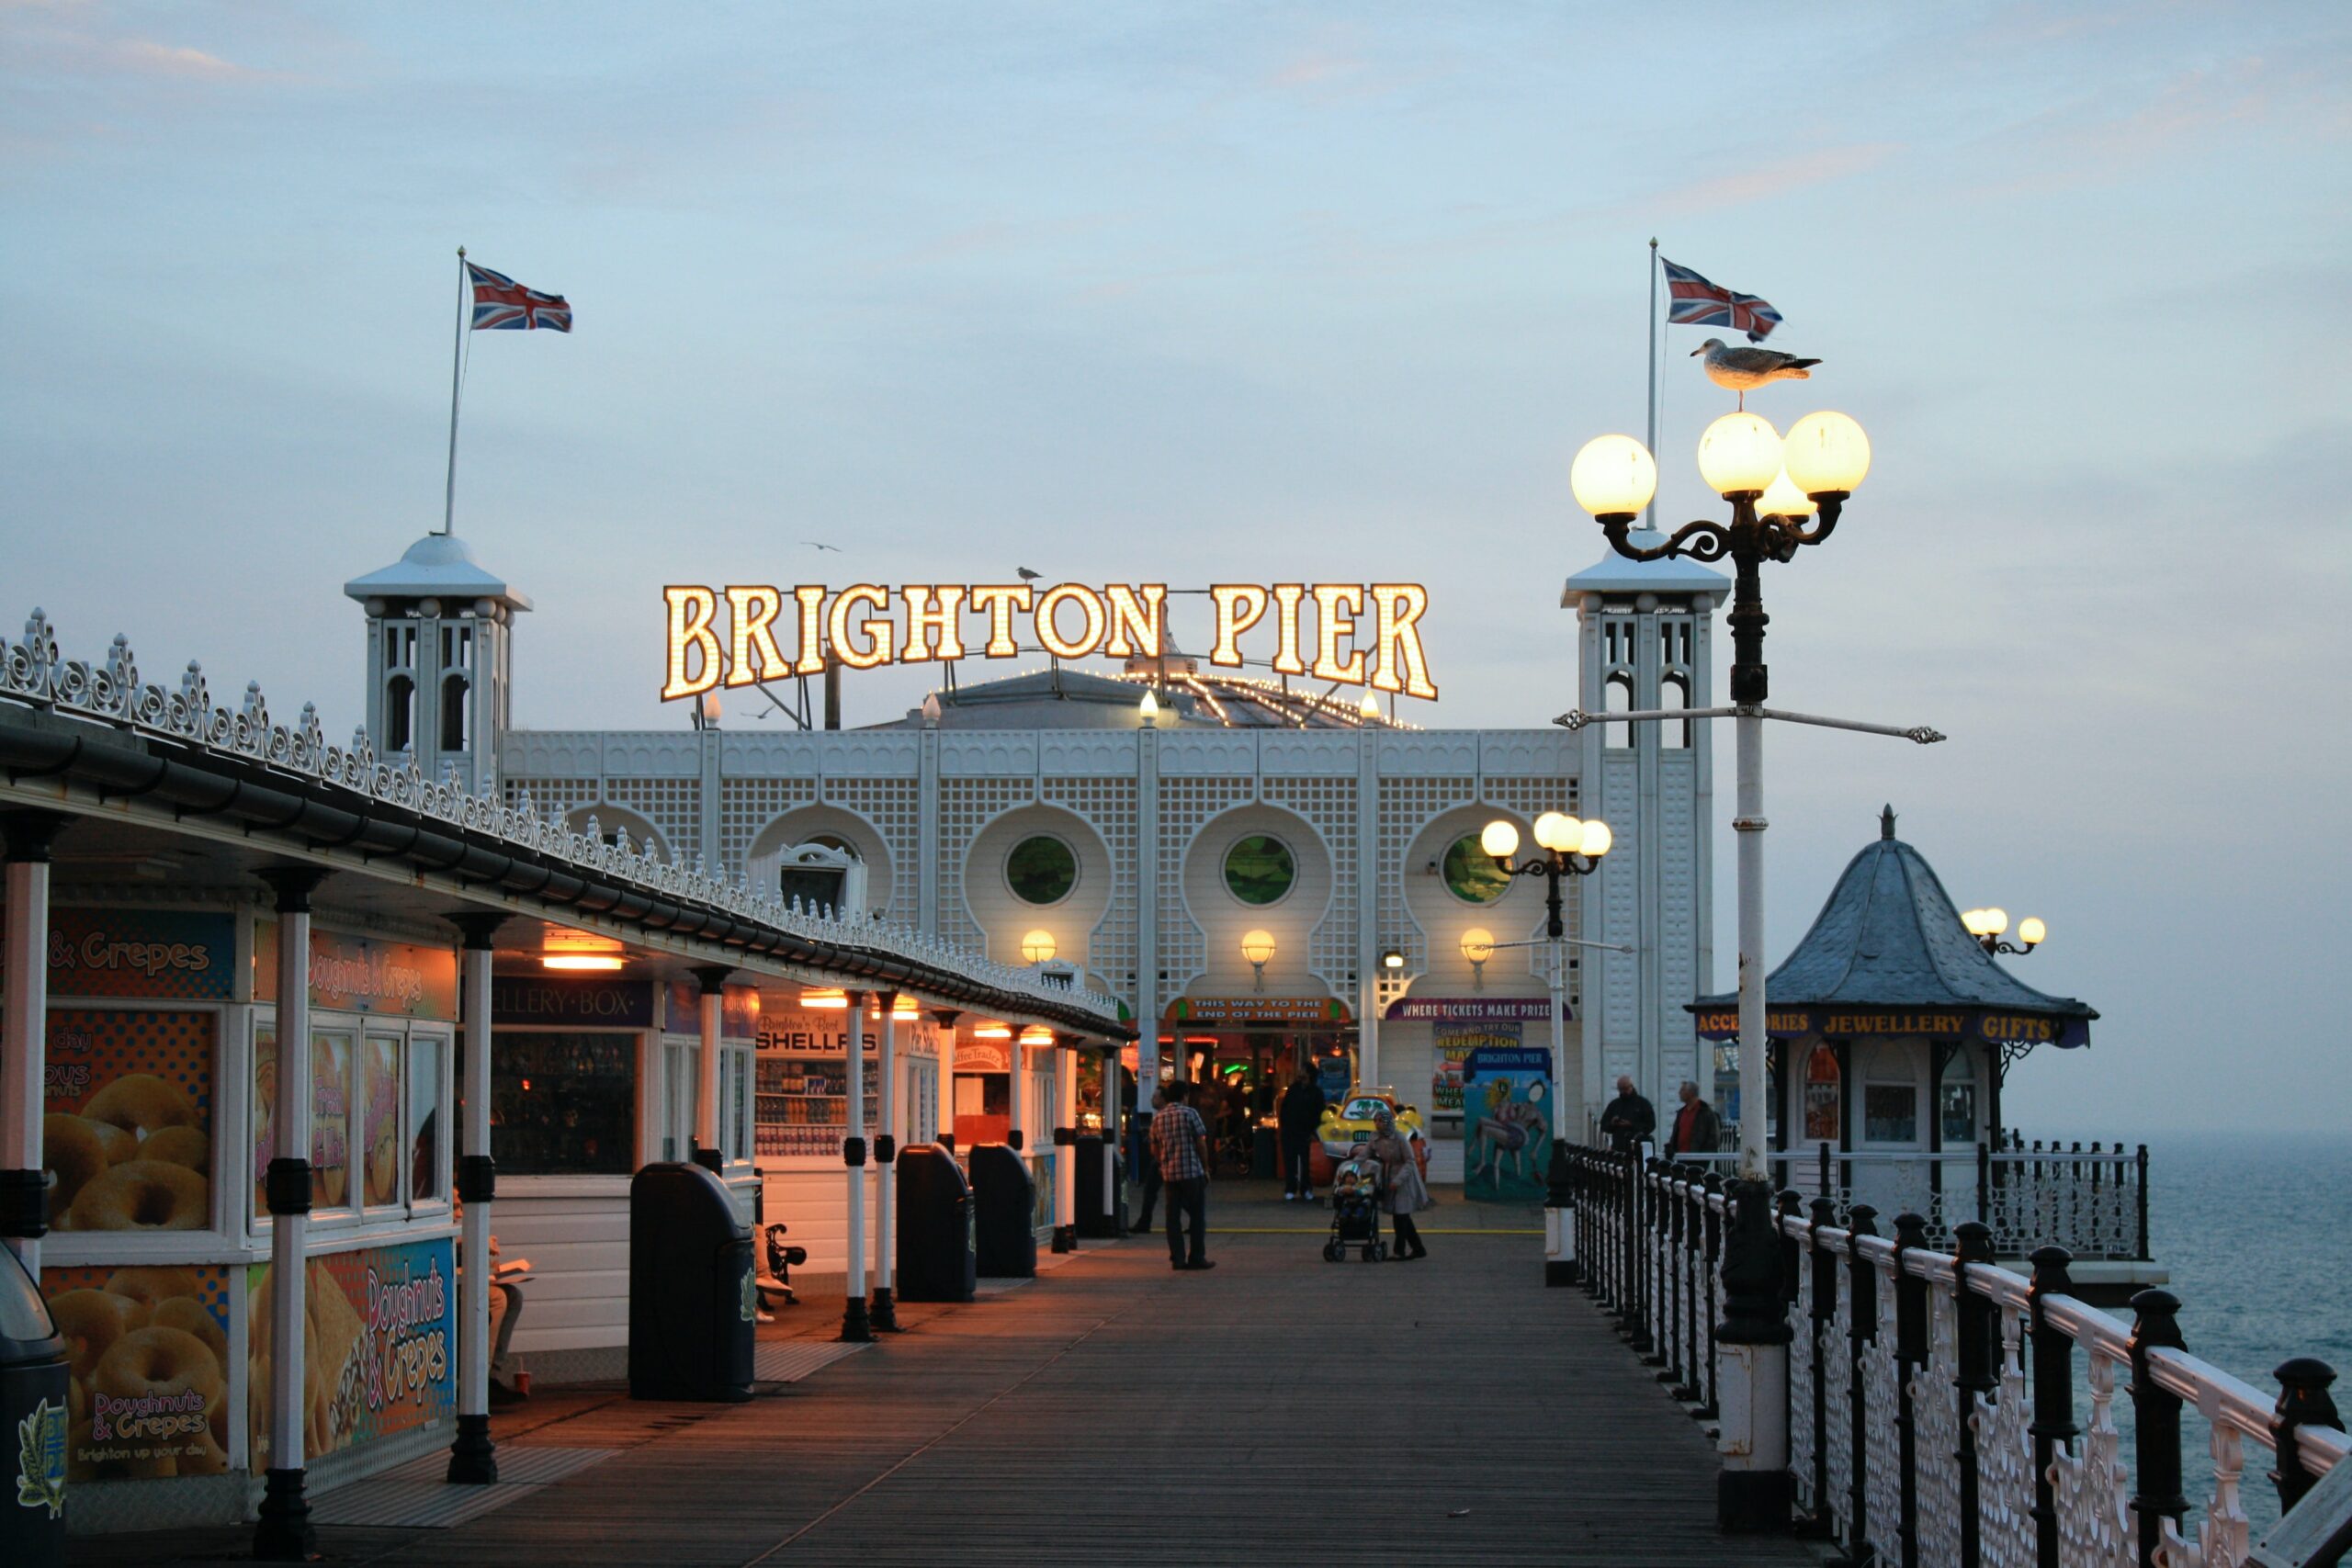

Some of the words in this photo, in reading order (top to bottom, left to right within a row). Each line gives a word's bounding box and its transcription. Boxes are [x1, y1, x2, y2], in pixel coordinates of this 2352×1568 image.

[661, 582, 1168, 702] BRIGHTON
[1209, 582, 1439, 702] PIER
[48, 931, 75, 969] &
[81, 931, 210, 976] Crepes
[309, 942, 371, 1000] Doughnuts
[382, 953, 423, 1008] Crepes
[493, 987, 568, 1015] ELLERY
[580, 989, 629, 1015] BOX
[1193, 999, 1226, 1008] THIS
[1231, 999, 1264, 1008] WAY
[1271, 999, 1290, 1008] TO
[1296, 999, 1322, 1008] THE
[1402, 1004, 1438, 1018] WHERE
[1442, 1004, 1483, 1018] TICKETS
[1487, 1004, 1517, 1018] MAKE
[1521, 1004, 1551, 1018] PRIZE
[813, 1014, 840, 1032] Best
[1196, 1010, 1226, 1019] END
[1231, 1010, 1250, 1019] OF
[1256, 1010, 1283, 1019] THE
[1287, 1010, 1319, 1019] PIER
[1698, 1012, 1809, 1033] ACCEORIES
[1824, 1014, 1965, 1034] JEWELLERY
[1983, 1015, 2052, 1040] GIFTS
[1435, 1027, 1461, 1037] COME
[1462, 1026, 1481, 1035] AND
[1501, 1022, 1521, 1032] OUR
[1436, 1034, 1519, 1047] REDEMPTION
[1477, 1053, 1521, 1065] BRIGHTON
[1523, 1053, 1543, 1065] PIER
[368, 1256, 445, 1337] Doughnuts
[368, 1334, 384, 1412] &
[385, 1328, 446, 1404] Crepes
[94, 1388, 206, 1417] Doughnuts
[93, 1415, 113, 1440] &
[116, 1414, 207, 1440] Crepes
[78, 1446, 130, 1462] Brighton
[134, 1449, 150, 1461] up
[153, 1447, 183, 1459] your
